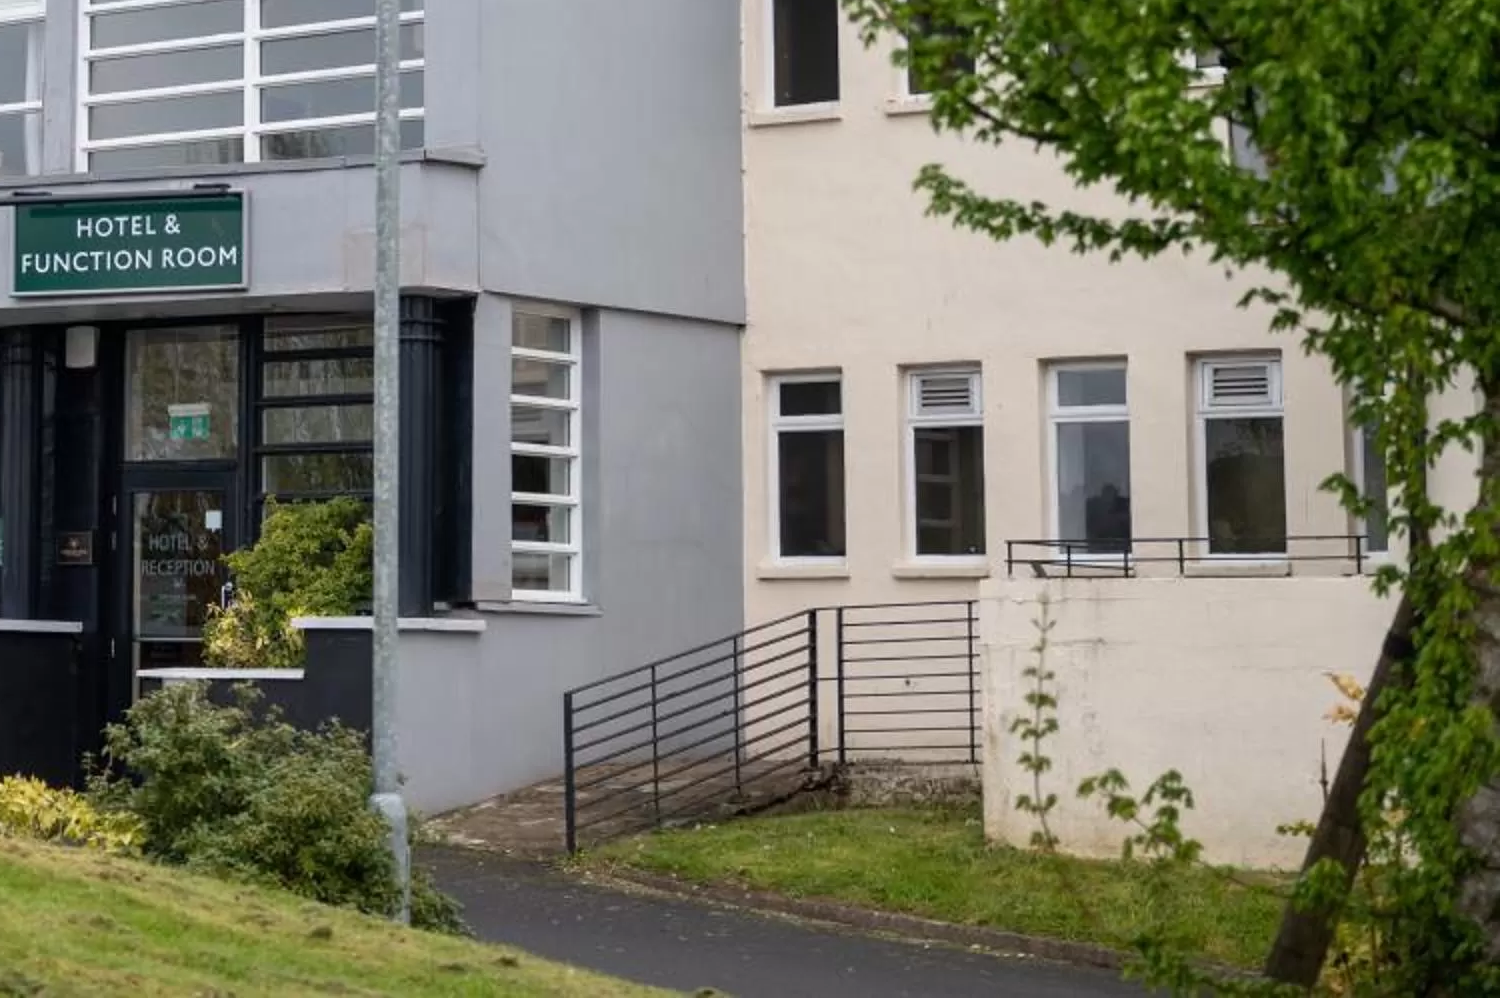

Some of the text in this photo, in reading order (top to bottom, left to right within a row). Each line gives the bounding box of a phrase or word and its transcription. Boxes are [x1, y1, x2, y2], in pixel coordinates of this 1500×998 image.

[76, 213, 181, 239] HOTEL &
[21, 245, 238, 274] FUNCTION ROOM
[148, 533, 192, 551] HOTEL
[141, 559, 216, 577] RECEPTION
